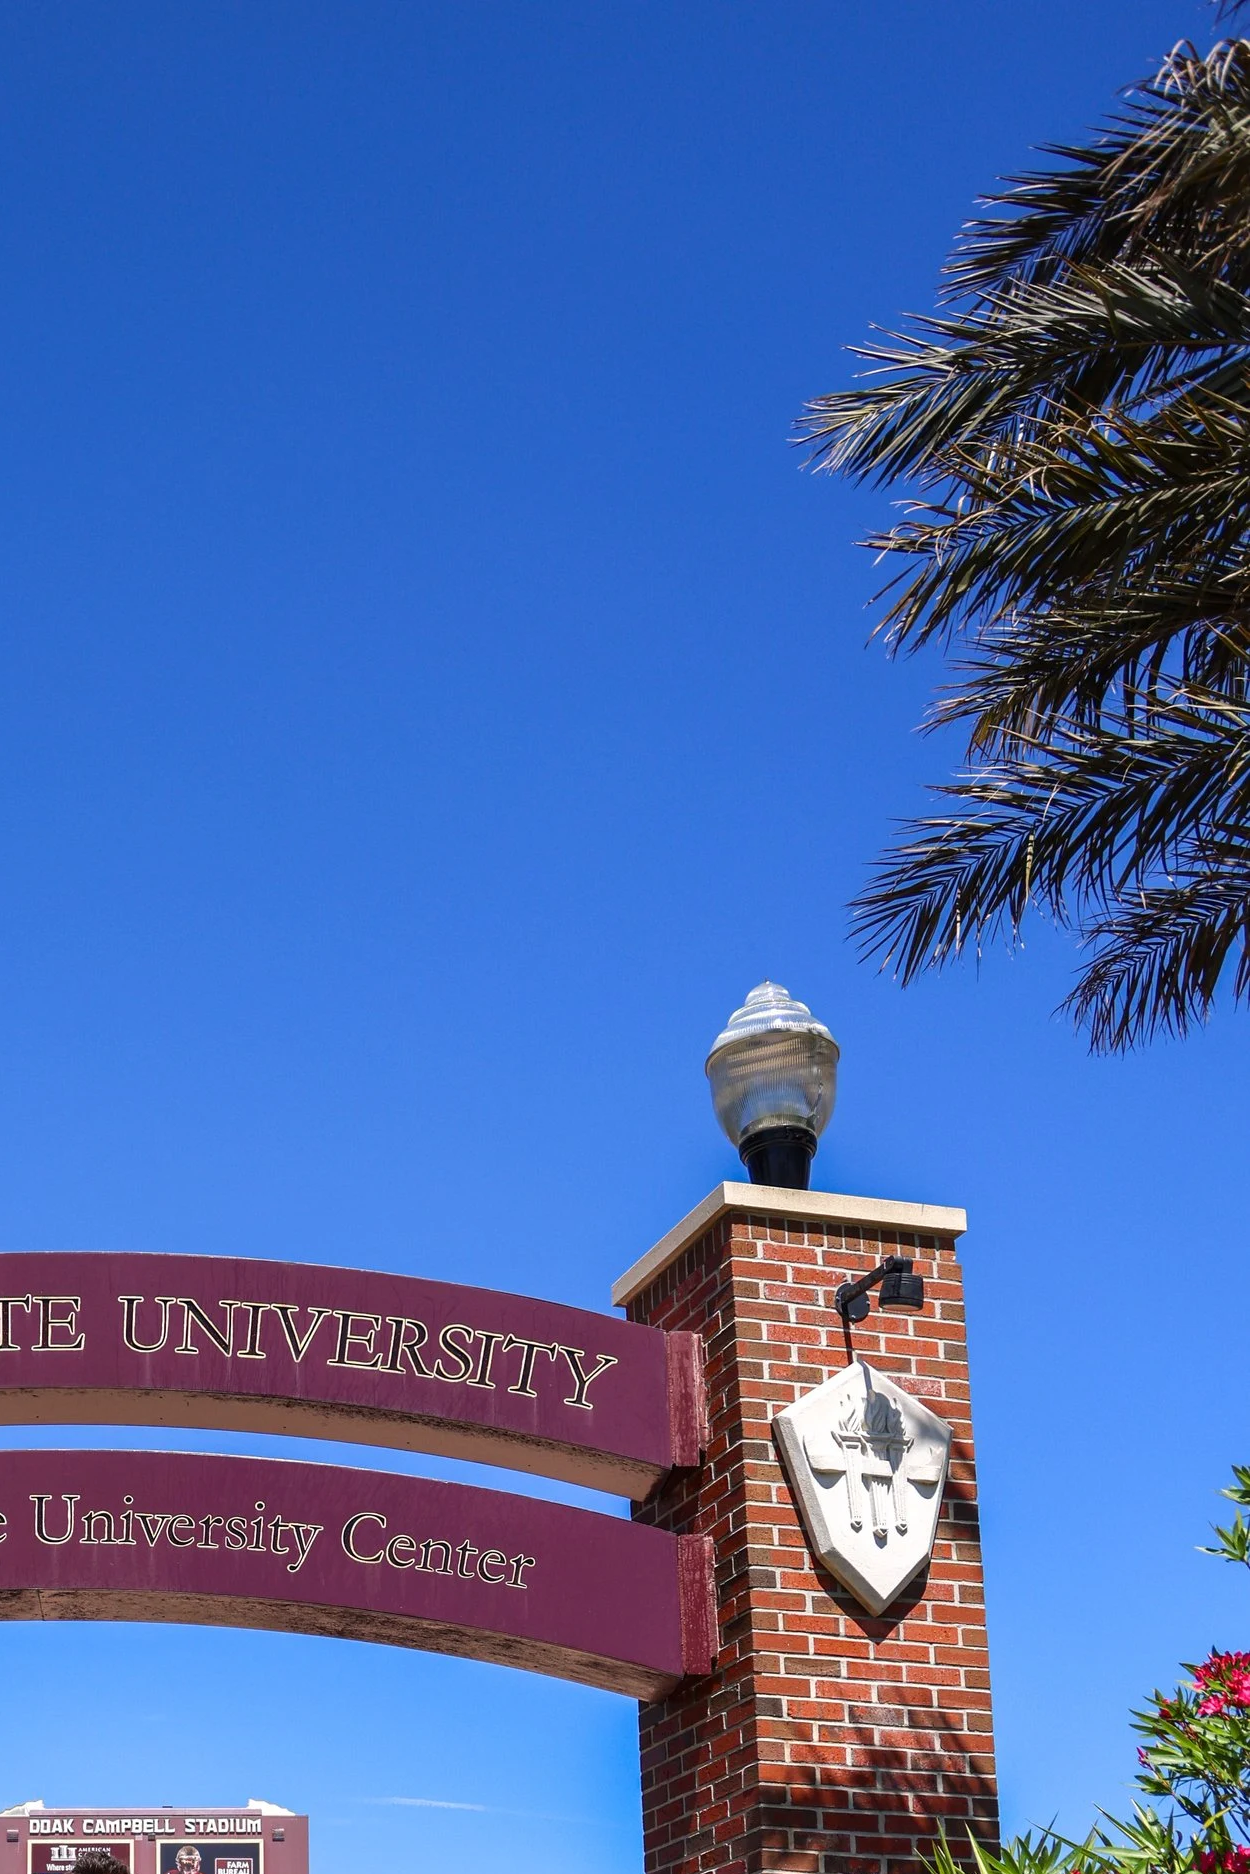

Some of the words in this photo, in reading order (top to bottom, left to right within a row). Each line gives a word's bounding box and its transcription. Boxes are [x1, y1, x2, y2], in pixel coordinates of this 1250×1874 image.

[118, 1296, 618, 1410] UNIVERSITY
[29, 1495, 324, 1572] University
[341, 1512, 536, 1589] Center
[29, 1818, 75, 1834] DOAK
[82, 1818, 175, 1834] CAMPBELL
[184, 1818, 262, 1834] STADIUM
[46, 1863, 65, 1872] Where
[226, 1861, 250, 1869] FARM
